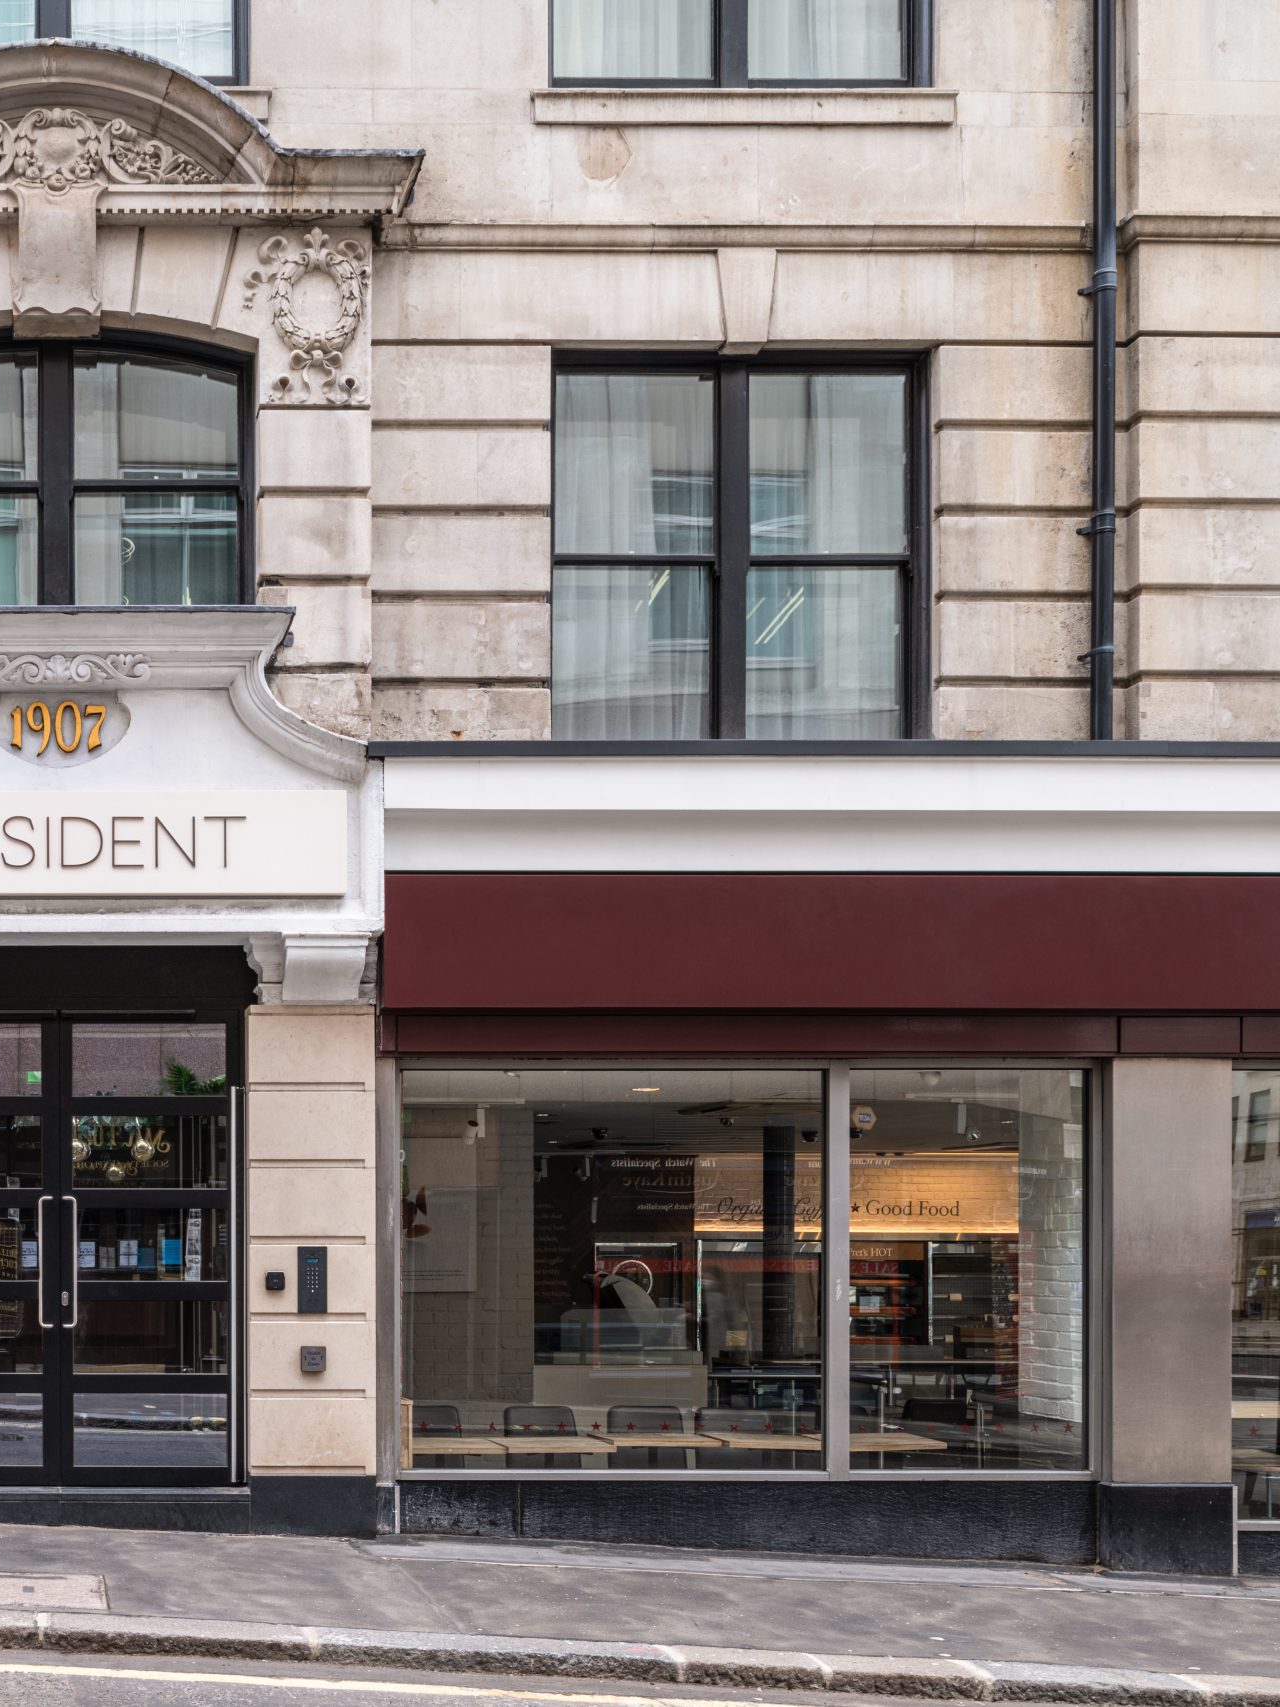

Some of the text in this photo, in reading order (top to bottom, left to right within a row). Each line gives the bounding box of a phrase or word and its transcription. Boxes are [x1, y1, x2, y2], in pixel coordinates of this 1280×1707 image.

[9, 699, 107, 758] 1907
[717, 1196, 764, 1222] Orga
[865, 1199, 912, 1217] Good
[918, 1199, 960, 1217] Food
[870, 1247, 893, 1257] HOT
